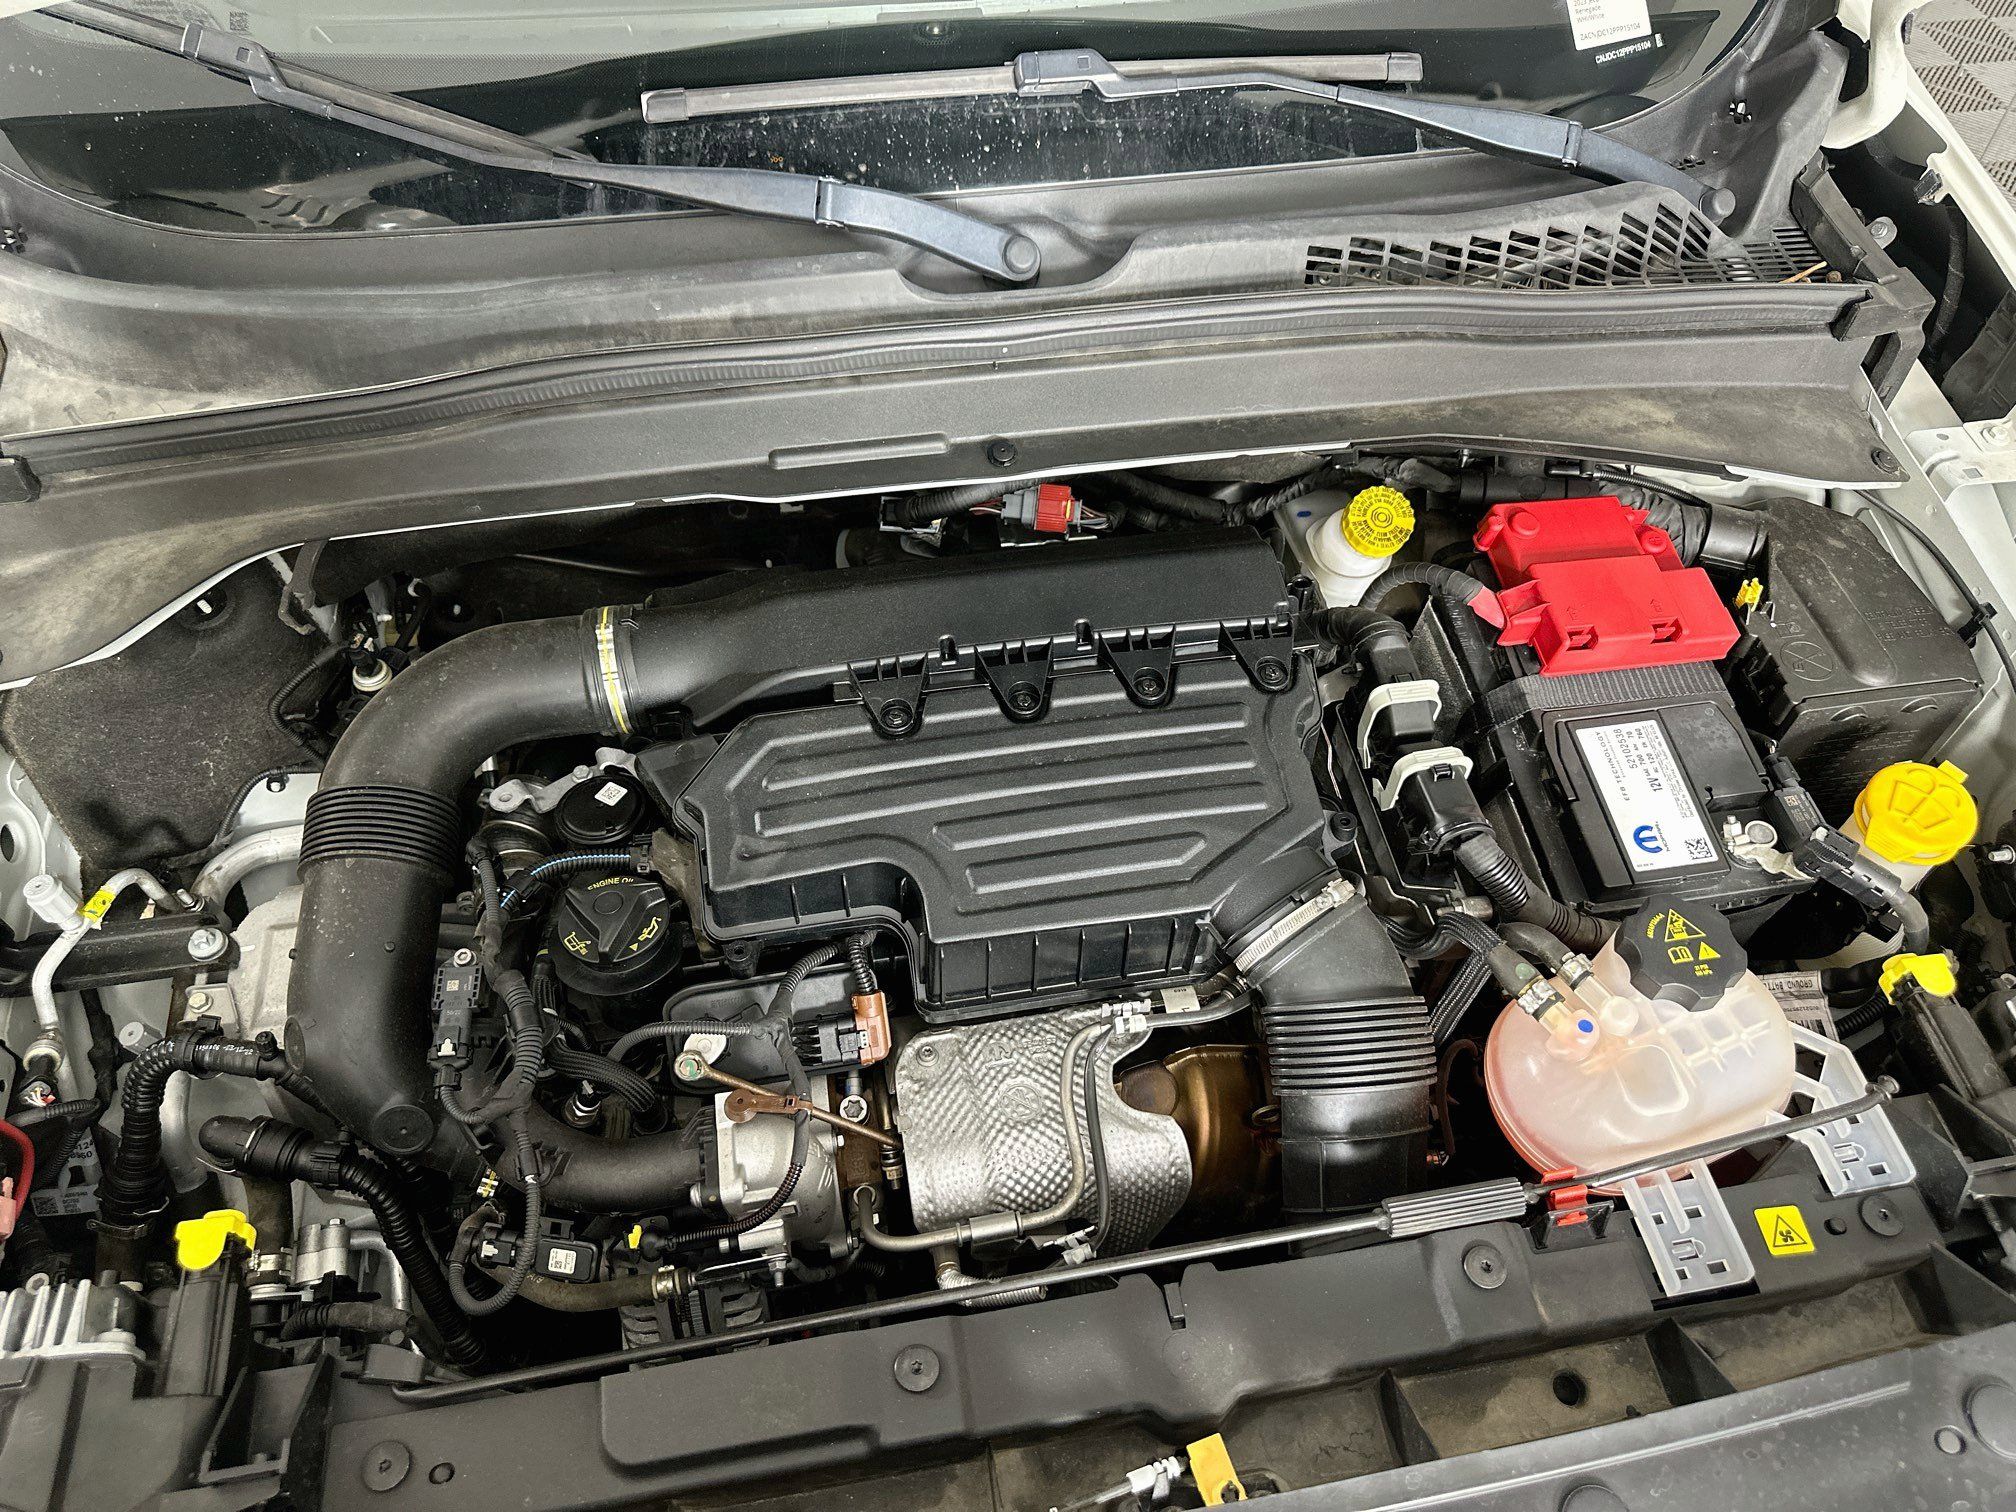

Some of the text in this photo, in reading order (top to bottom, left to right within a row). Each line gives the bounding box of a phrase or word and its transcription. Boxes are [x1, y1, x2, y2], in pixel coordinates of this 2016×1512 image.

[1594, 730, 1622, 782] TECHNOLOGY
[1612, 728, 1638, 769] 52102538
[1646, 776, 1663, 792] 12V
[587, 877, 620, 891] ENGINE
